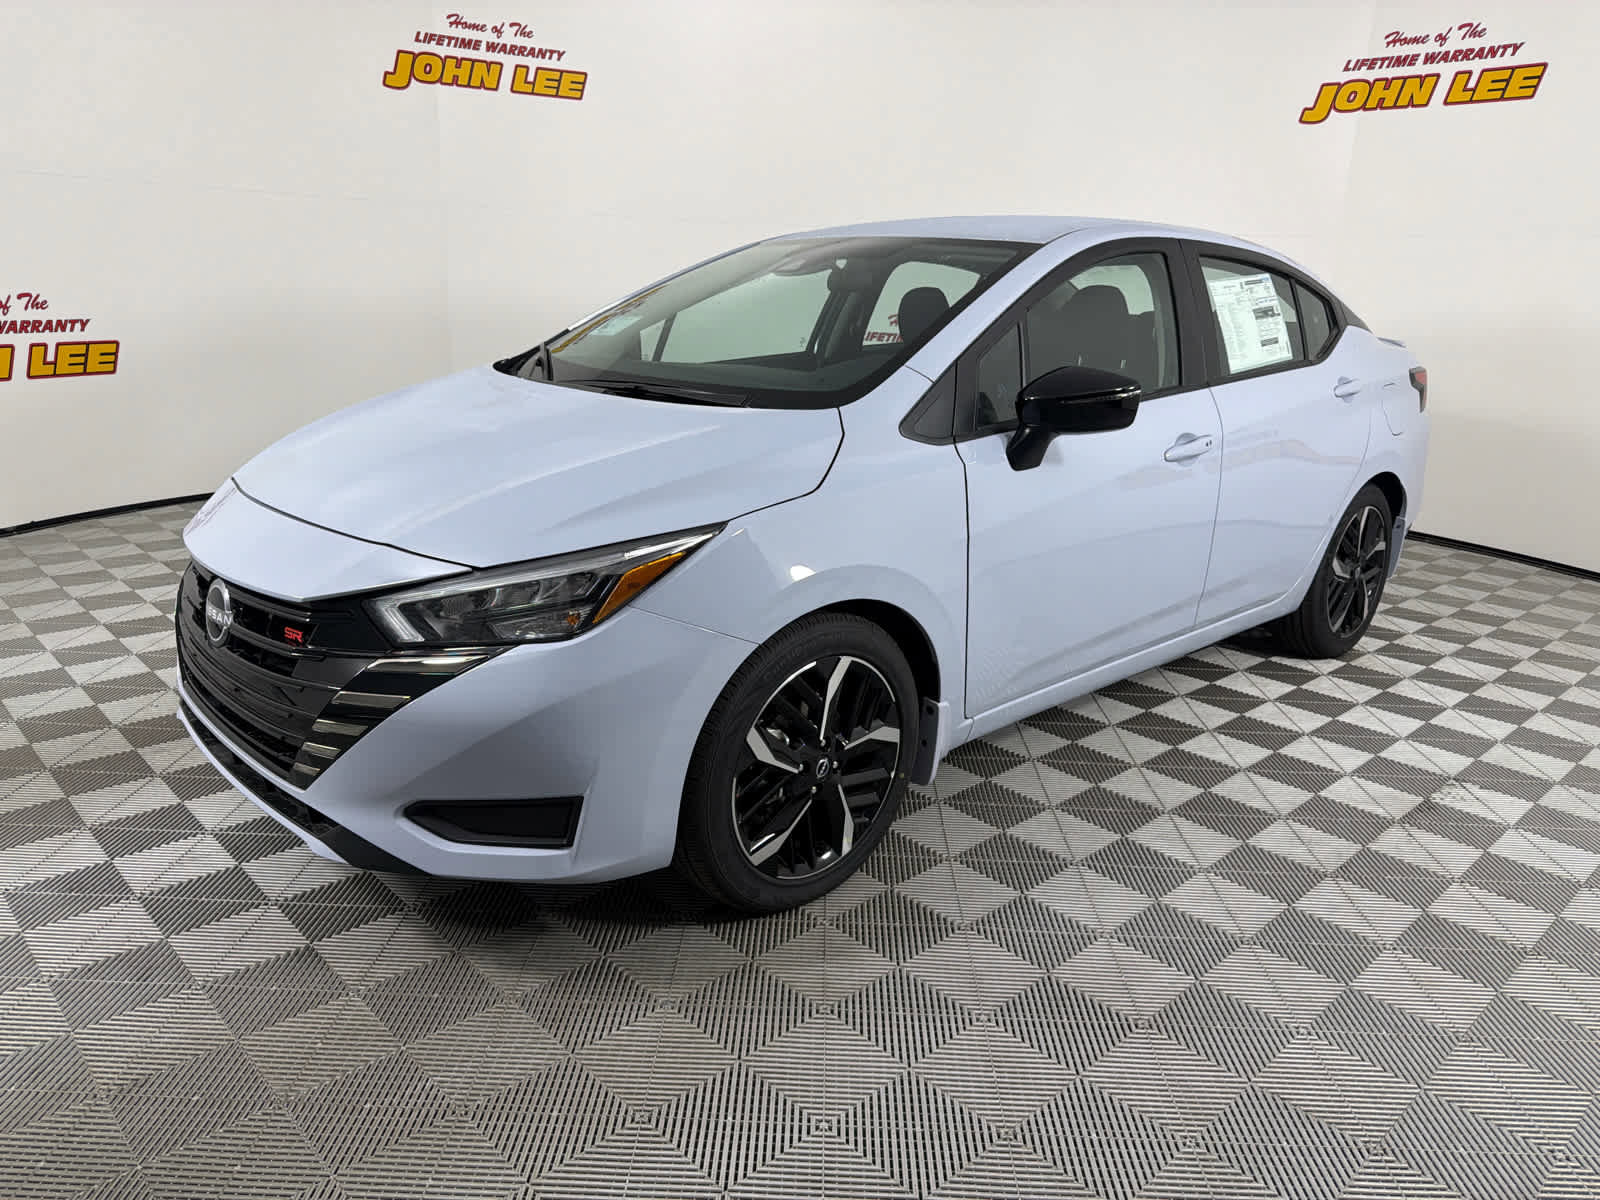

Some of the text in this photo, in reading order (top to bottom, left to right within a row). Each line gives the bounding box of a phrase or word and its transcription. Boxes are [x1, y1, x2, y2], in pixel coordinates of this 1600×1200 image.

[446, 13, 535, 39] Home of The
[1384, 22, 1487, 48] Home of The
[414, 31, 566, 62] LIFETIME WARRANTY
[1342, 41, 1525, 72] LIFETIME WARRANTY
[383, 49, 588, 100] JOHN LEE
[1298, 62, 1549, 125] JOHN LEE
[16, 292, 48, 311] The
[26, 340, 120, 380] LEE
[284, 626, 303, 643] SR
